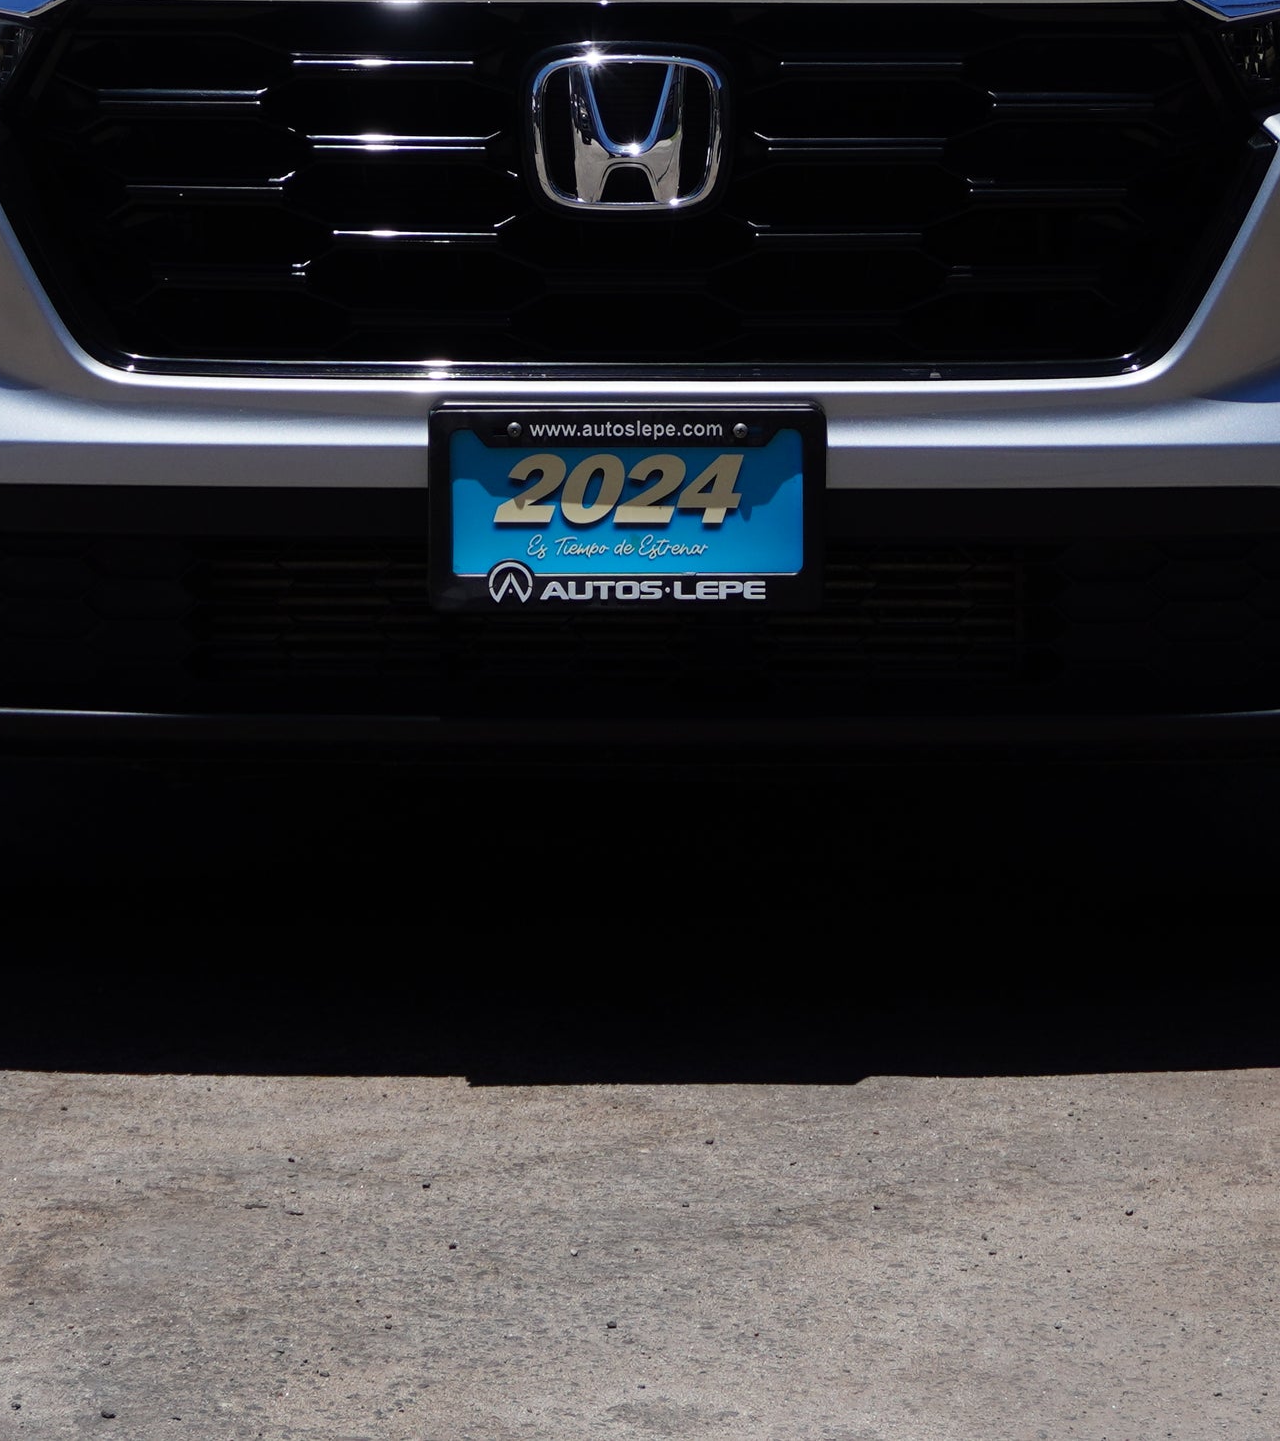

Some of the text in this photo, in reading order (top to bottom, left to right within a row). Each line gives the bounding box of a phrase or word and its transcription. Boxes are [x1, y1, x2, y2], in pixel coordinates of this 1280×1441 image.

[529, 419, 723, 441] www.autoslepe.com
[493, 453, 745, 524] 2024
[527, 534, 709, 560] Es Tiempo de Estrenar
